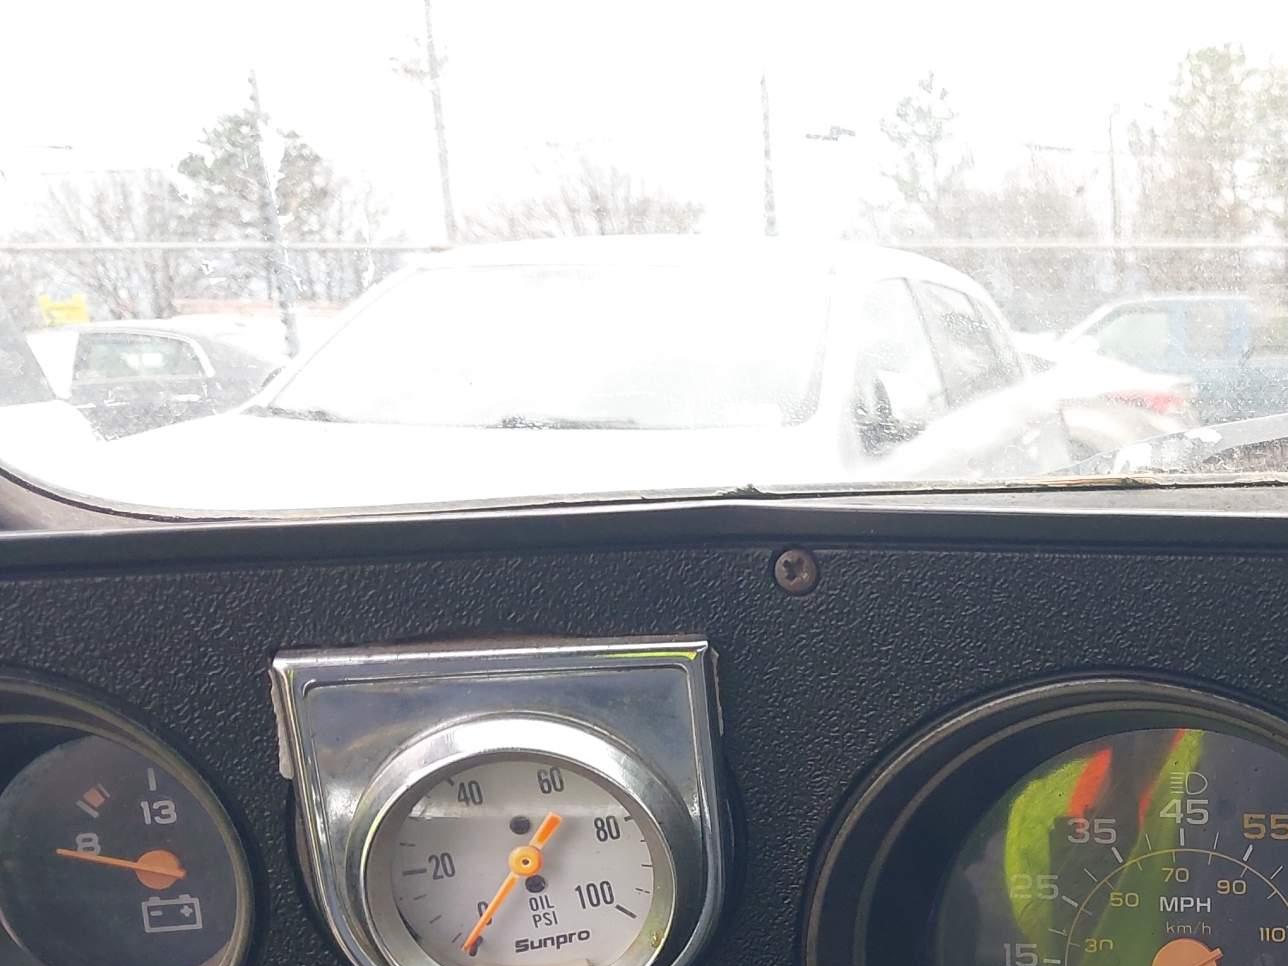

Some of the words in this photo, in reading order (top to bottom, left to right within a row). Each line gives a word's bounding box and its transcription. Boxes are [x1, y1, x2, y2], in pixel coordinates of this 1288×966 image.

[537, 767, 564, 794] 60
[457, 780, 483, 806] 40
[140, 800, 177, 825] 13
[1159, 799, 1209, 825] 45
[593, 816, 621, 842] 80
[1067, 818, 1117, 845] 35
[76, 832, 101, 855] 8
[428, 852, 456, 880] 20
[1161, 868, 1190, 883] 70
[575, 880, 614, 910] 100
[1009, 874, 1059, 899] 25
[1216, 880, 1247, 896] 90
[528, 895, 555, 912] OIL
[1110, 892, 1139, 907] 50
[1159, 897, 1211, 912] MPH
[532, 911, 558, 928] PSI
[1166, 921, 1212, 936] km/h
[515, 929, 591, 953] Sunpro
[1084, 938, 1113, 952] 30
[1259, 927, 1286, 943] 110
